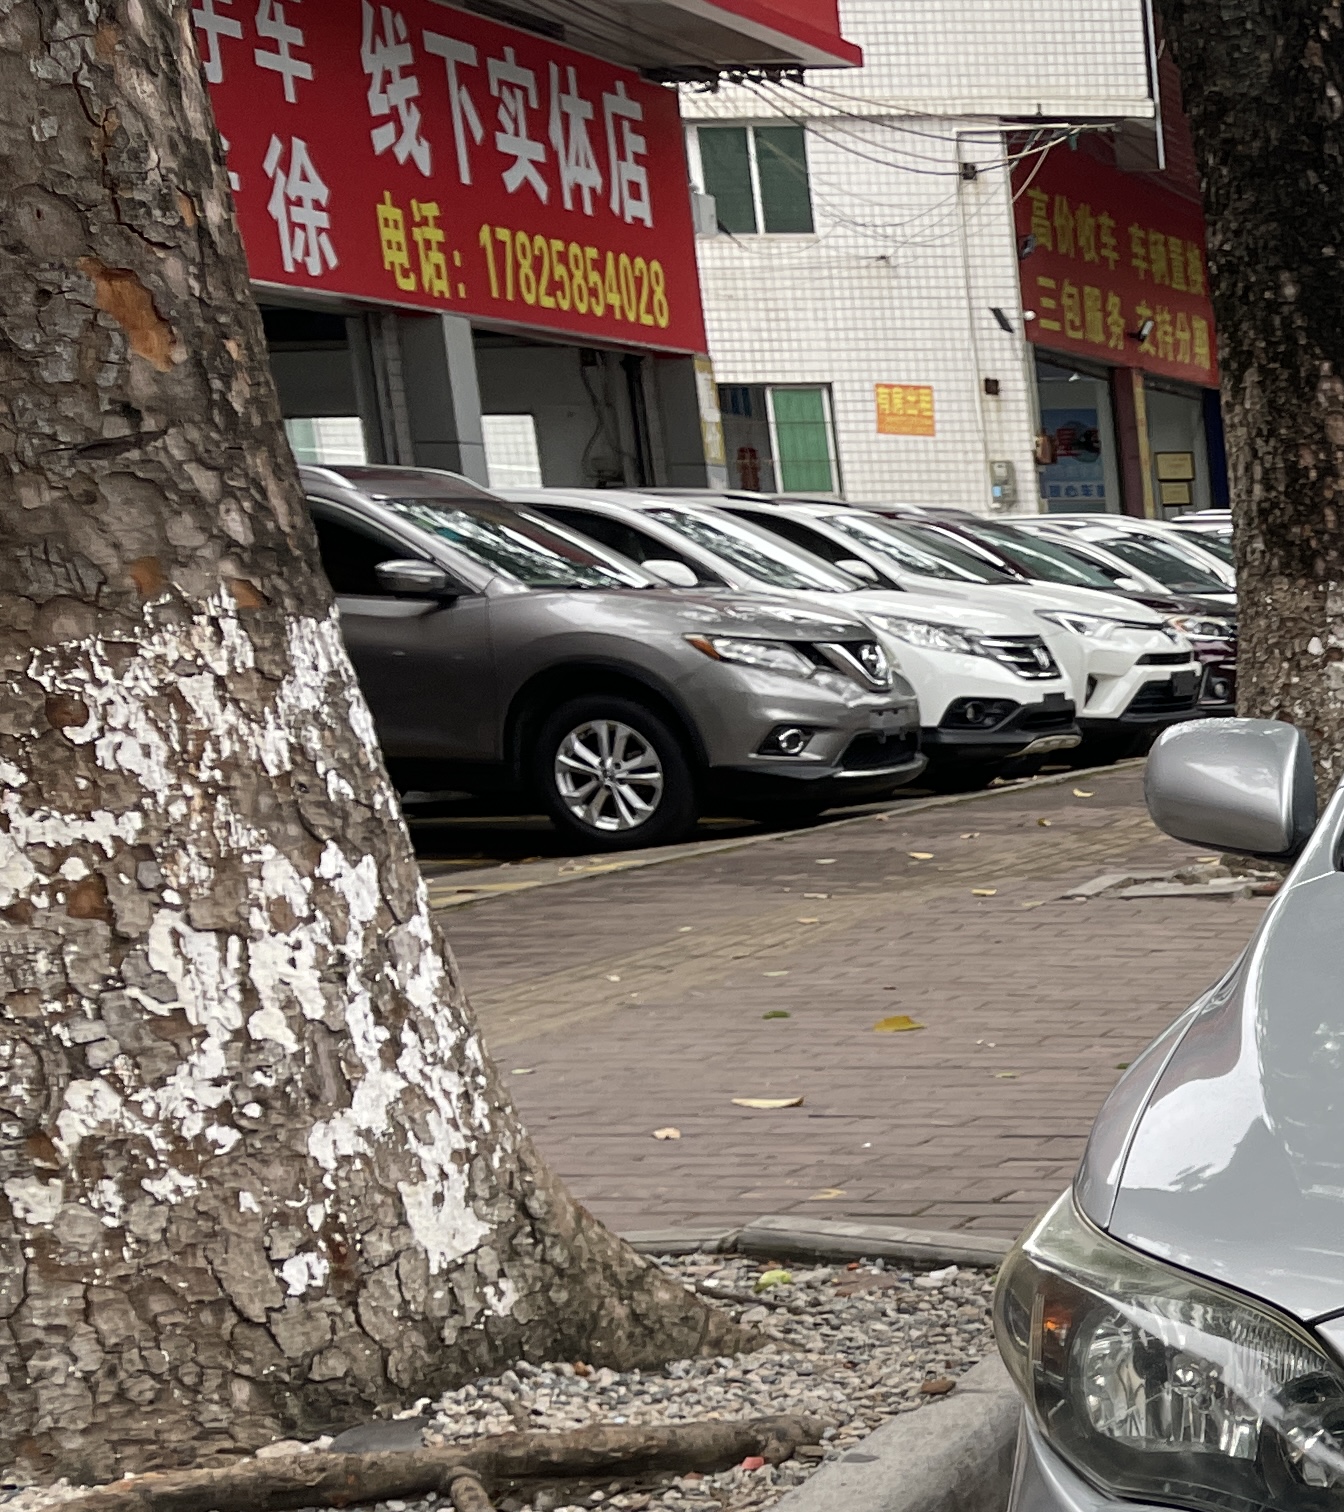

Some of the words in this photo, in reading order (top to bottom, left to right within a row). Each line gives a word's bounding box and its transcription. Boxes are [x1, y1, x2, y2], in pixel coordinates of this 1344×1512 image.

[360, 0, 654, 228] 线下实体店
[1027, 186, 1120, 271] 高价收车
[1036, 276, 1126, 351] 三包服务
